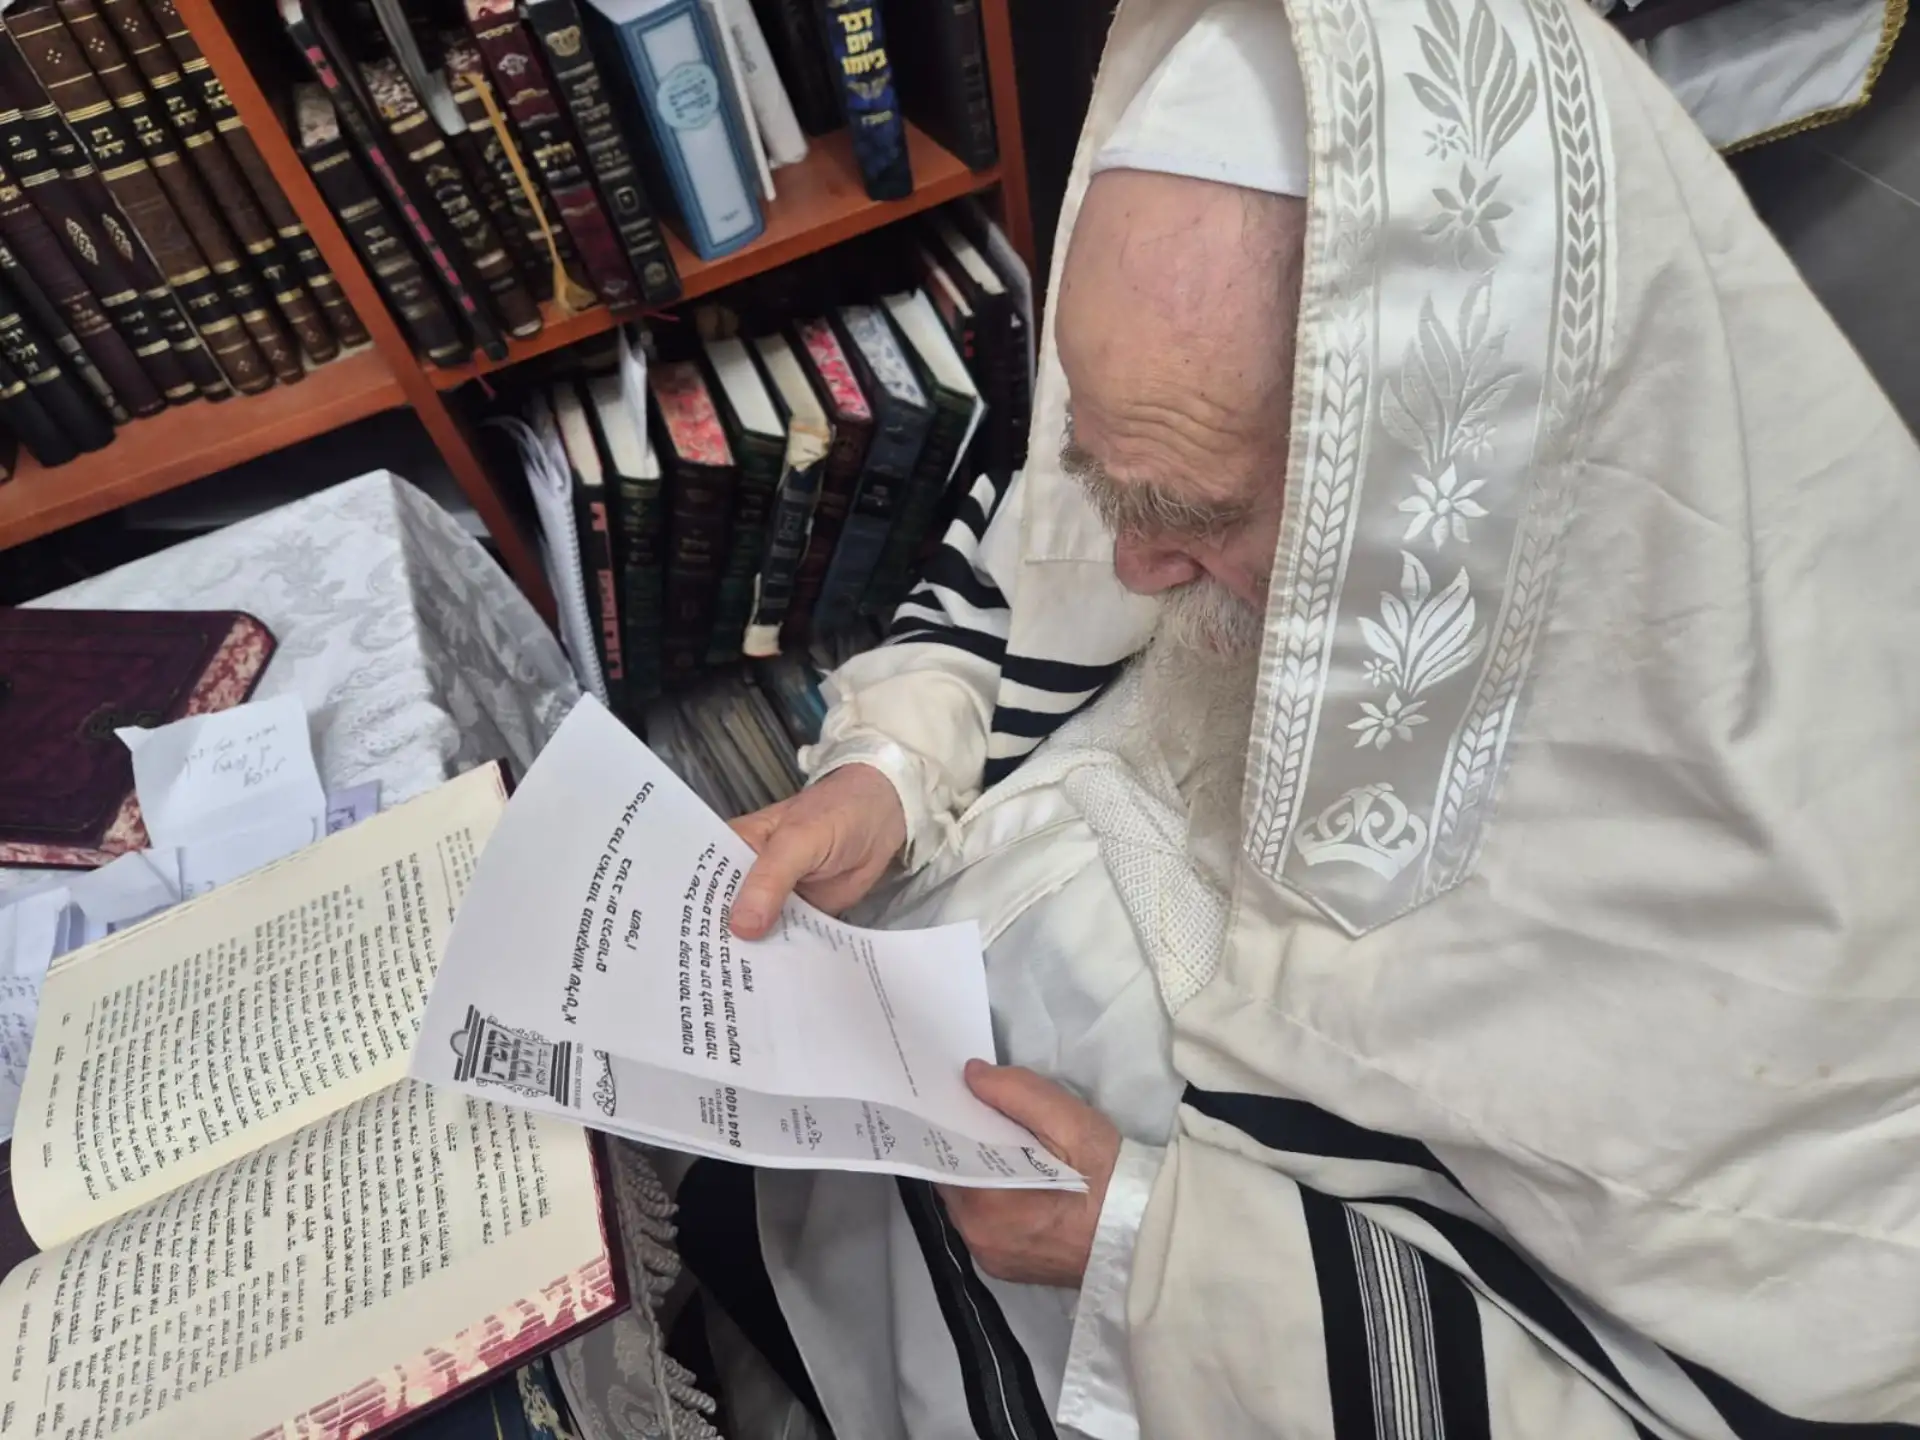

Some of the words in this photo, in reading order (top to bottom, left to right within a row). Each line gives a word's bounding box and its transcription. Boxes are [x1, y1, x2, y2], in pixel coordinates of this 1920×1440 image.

[836, 7, 873, 32] דבר
[845, 31, 873, 54] יום
[841, 48, 887, 75] ביומו
[622, 781, 655, 826] תפילת
[607, 826, 624, 853] מרן
[697, 842, 716, 871] יה"ר
[587, 854, 612, 905] האדמור
[612, 858, 632, 895] בערב
[684, 875, 701, 901] שכל
[702, 856, 730, 916] והרשומים
[723, 868, 742, 902] טובה
[607, 895, 617, 915] יום
[681, 905, 693, 937] תורמי
[698, 918, 710, 938] בכל
[596, 918, 613, 972] הכיפורים
[679, 940, 692, 970] קופת
[700, 941, 713, 968] מקום
[701, 970, 712, 989] יזכו
[720, 946, 732, 988] בבריאות
[741, 958, 753, 992] דשמיא
[679, 972, 690, 1002] החסד
[699, 991, 713, 1017] לגמר
[723, 990, 736, 1023] איתנה
[680, 1006, 694, 1055] הרשומים
[704, 1021, 718, 1060] חתימה
[727, 1025, 740, 1066] וסיעתא
[484, 1029, 514, 1080] קופת
[725, 1087, 741, 1149] 8441400
